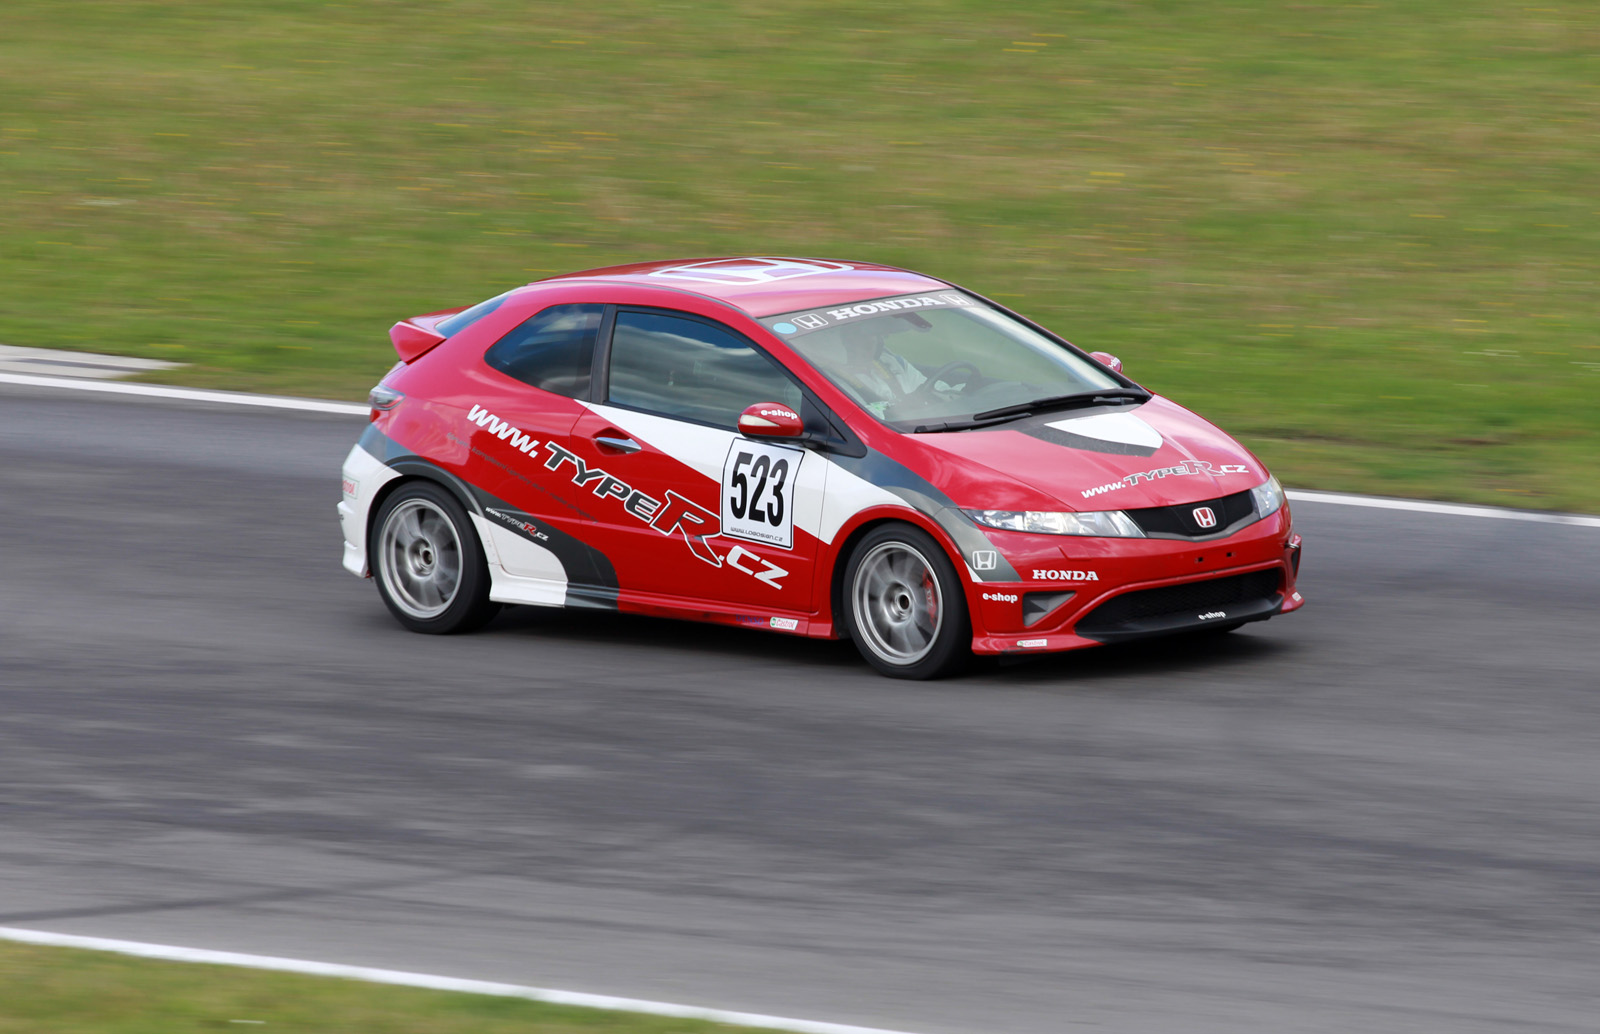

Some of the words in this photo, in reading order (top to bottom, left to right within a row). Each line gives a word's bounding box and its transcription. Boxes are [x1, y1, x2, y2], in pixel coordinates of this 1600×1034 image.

[827, 296, 946, 320] HONDA
[760, 409, 798, 420] e-shop
[730, 451, 788, 527] 523
[1032, 569, 1099, 581] HONDA
[982, 592, 1018, 603] e-shop
[1198, 611, 1226, 620] e-shop
